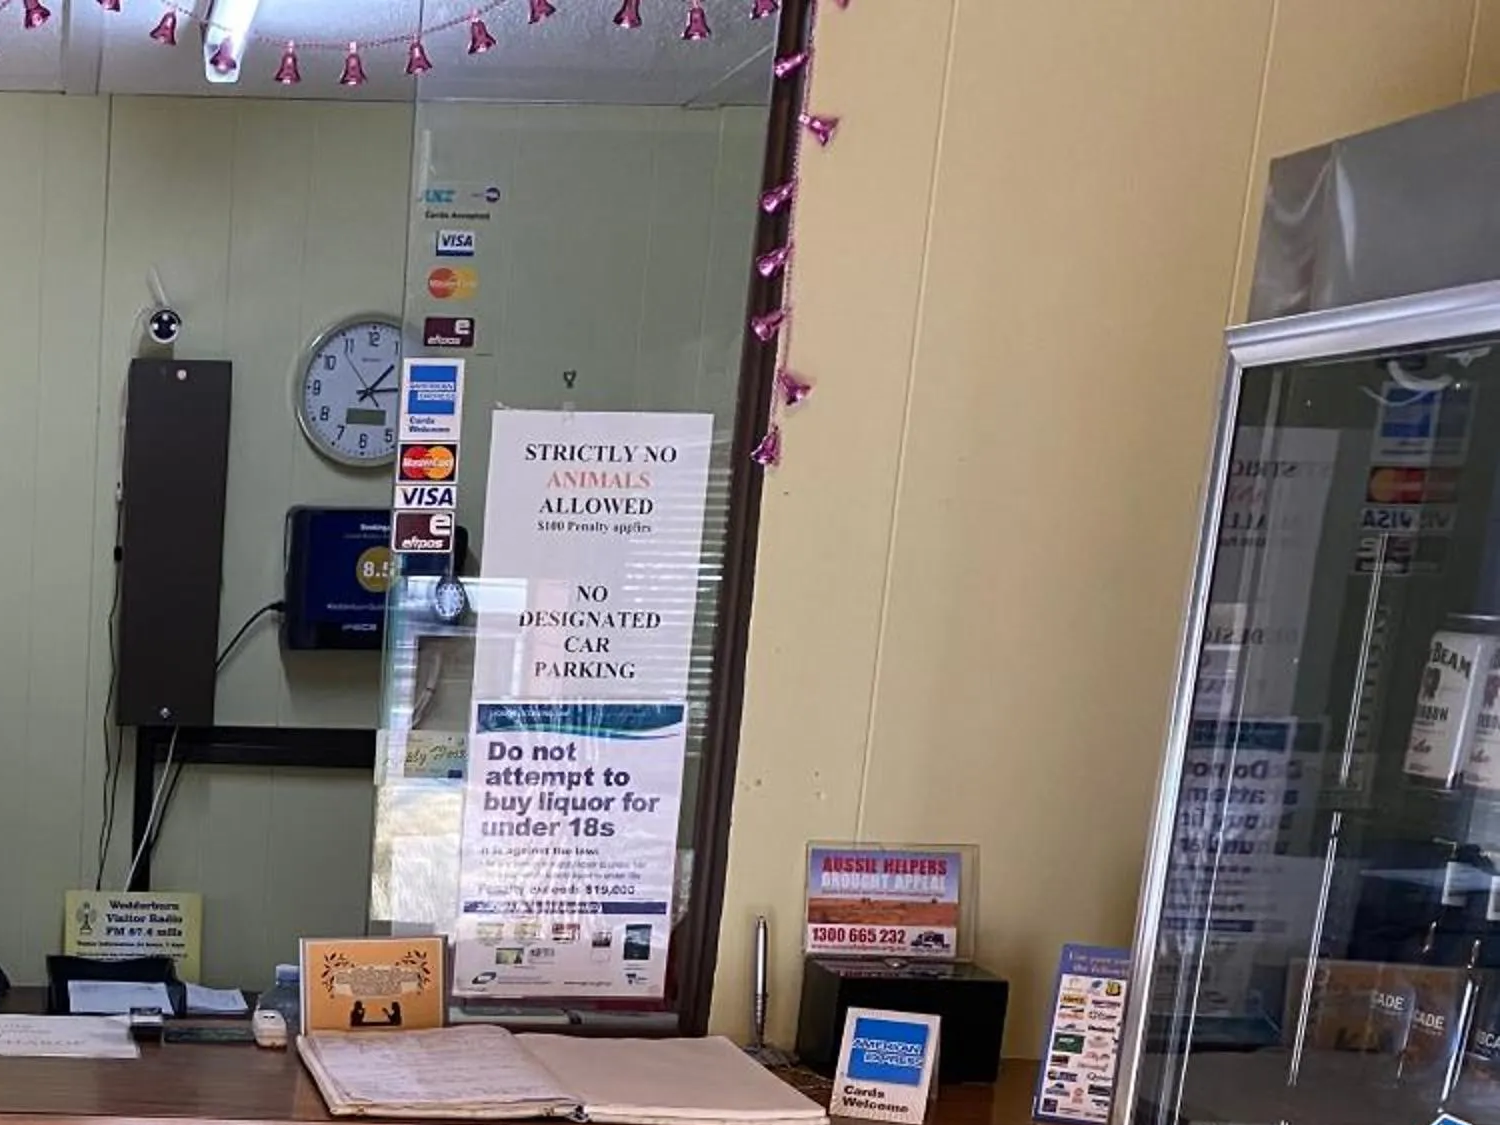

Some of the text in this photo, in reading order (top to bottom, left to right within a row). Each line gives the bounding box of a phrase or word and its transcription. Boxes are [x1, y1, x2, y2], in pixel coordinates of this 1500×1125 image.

[441, 234, 473, 247] VISA
[344, 338, 355, 354] 11
[369, 331, 380, 347] 12
[324, 354, 337, 370] 10
[312, 379, 321, 396] 9
[320, 405, 330, 421] 8
[408, 415, 435, 425] Cards
[337, 424, 345, 441] 7
[359, 433, 367, 449] 6
[384, 427, 393, 443] 5
[525, 443, 677, 463] STRICTLY NO
[547, 471, 651, 489] ANIMALS
[402, 487, 453, 506] VISA
[540, 498, 653, 515] ALLOWED
[567, 521, 610, 534] Penalty
[613, 523, 652, 535] applies
[401, 536, 443, 550] eftpos
[576, 585, 608, 602] NO
[518, 610, 661, 629] DESIGNATED
[564, 635, 610, 653] CAR
[1431, 640, 1472, 680] BEAM
[534, 661, 636, 680] PARKING
[487, 741, 524, 761] Do
[531, 742, 577, 761] not
[485, 767, 631, 791] attempt to
[484, 792, 661, 817] buy liquor for
[481, 818, 616, 838] under 18s
[821, 856, 948, 876] AUSSIE HELPERS
[820, 872, 946, 891] DROUGHT APPEAL
[108, 899, 180, 911] Wedderburn
[106, 913, 183, 923] Visitor Radio
[106, 927, 126, 936] FM
[811, 927, 906, 944] 1300 665 232
[851, 1037, 923, 1055] AMERICAN
[843, 1084, 886, 1099] Cards
[842, 1095, 910, 1114] Welcome
